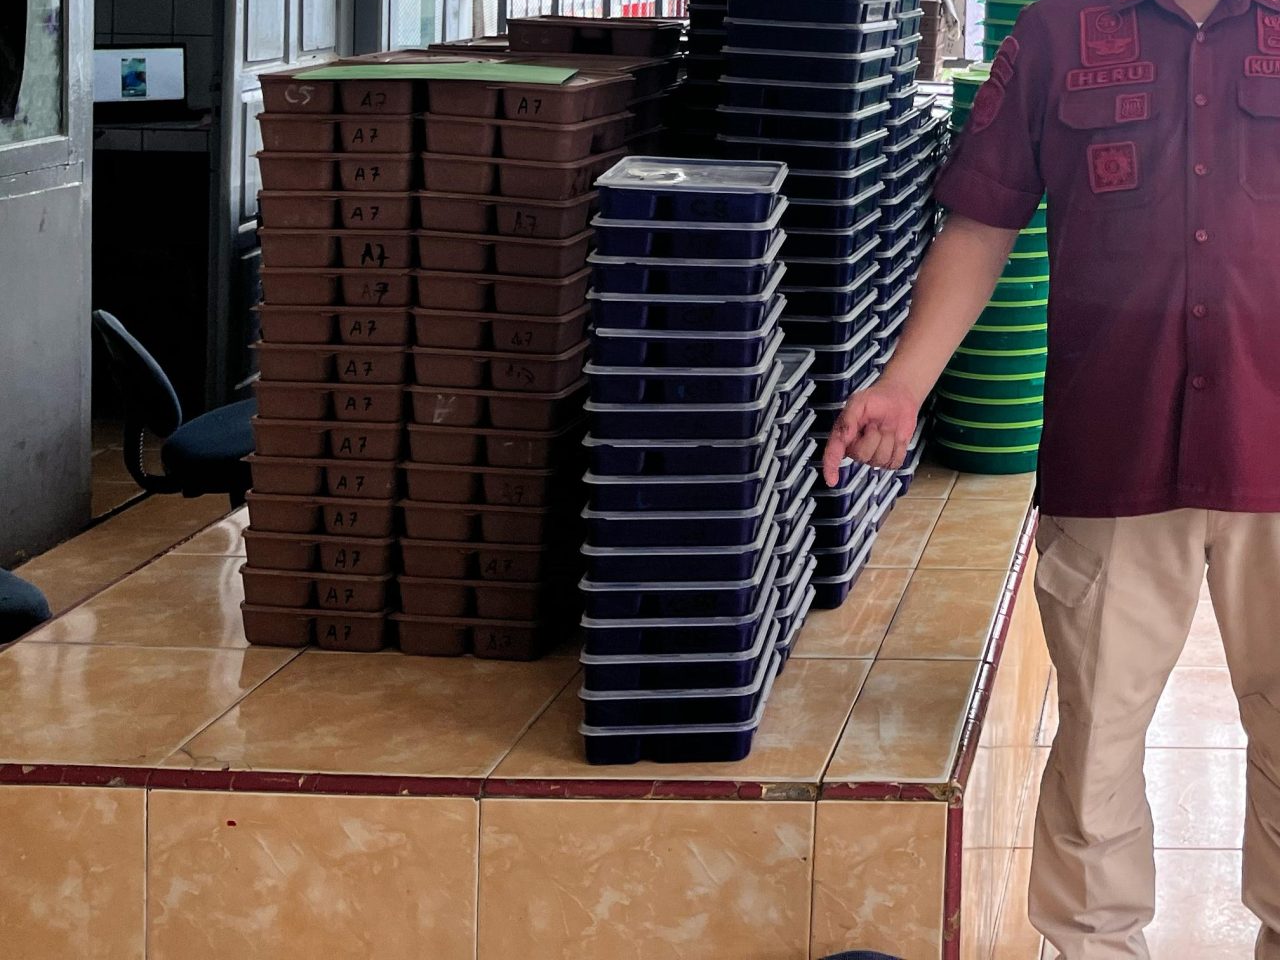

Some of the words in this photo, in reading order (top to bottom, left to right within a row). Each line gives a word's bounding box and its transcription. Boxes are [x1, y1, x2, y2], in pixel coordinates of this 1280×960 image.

[1077, 65, 1144, 86] HERU
[517, 97, 542, 114] A7
[352, 128, 379, 143] A7
[355, 166, 381, 181] A7
[351, 206, 380, 221] A7
[350, 320, 377, 336] A7
[344, 360, 374, 377] A7
[345, 397, 373, 411] A7
[340, 437, 367, 453] A7
[336, 476, 365, 491] A7
[333, 512, 358, 527] A7
[334, 550, 361, 568] A7
